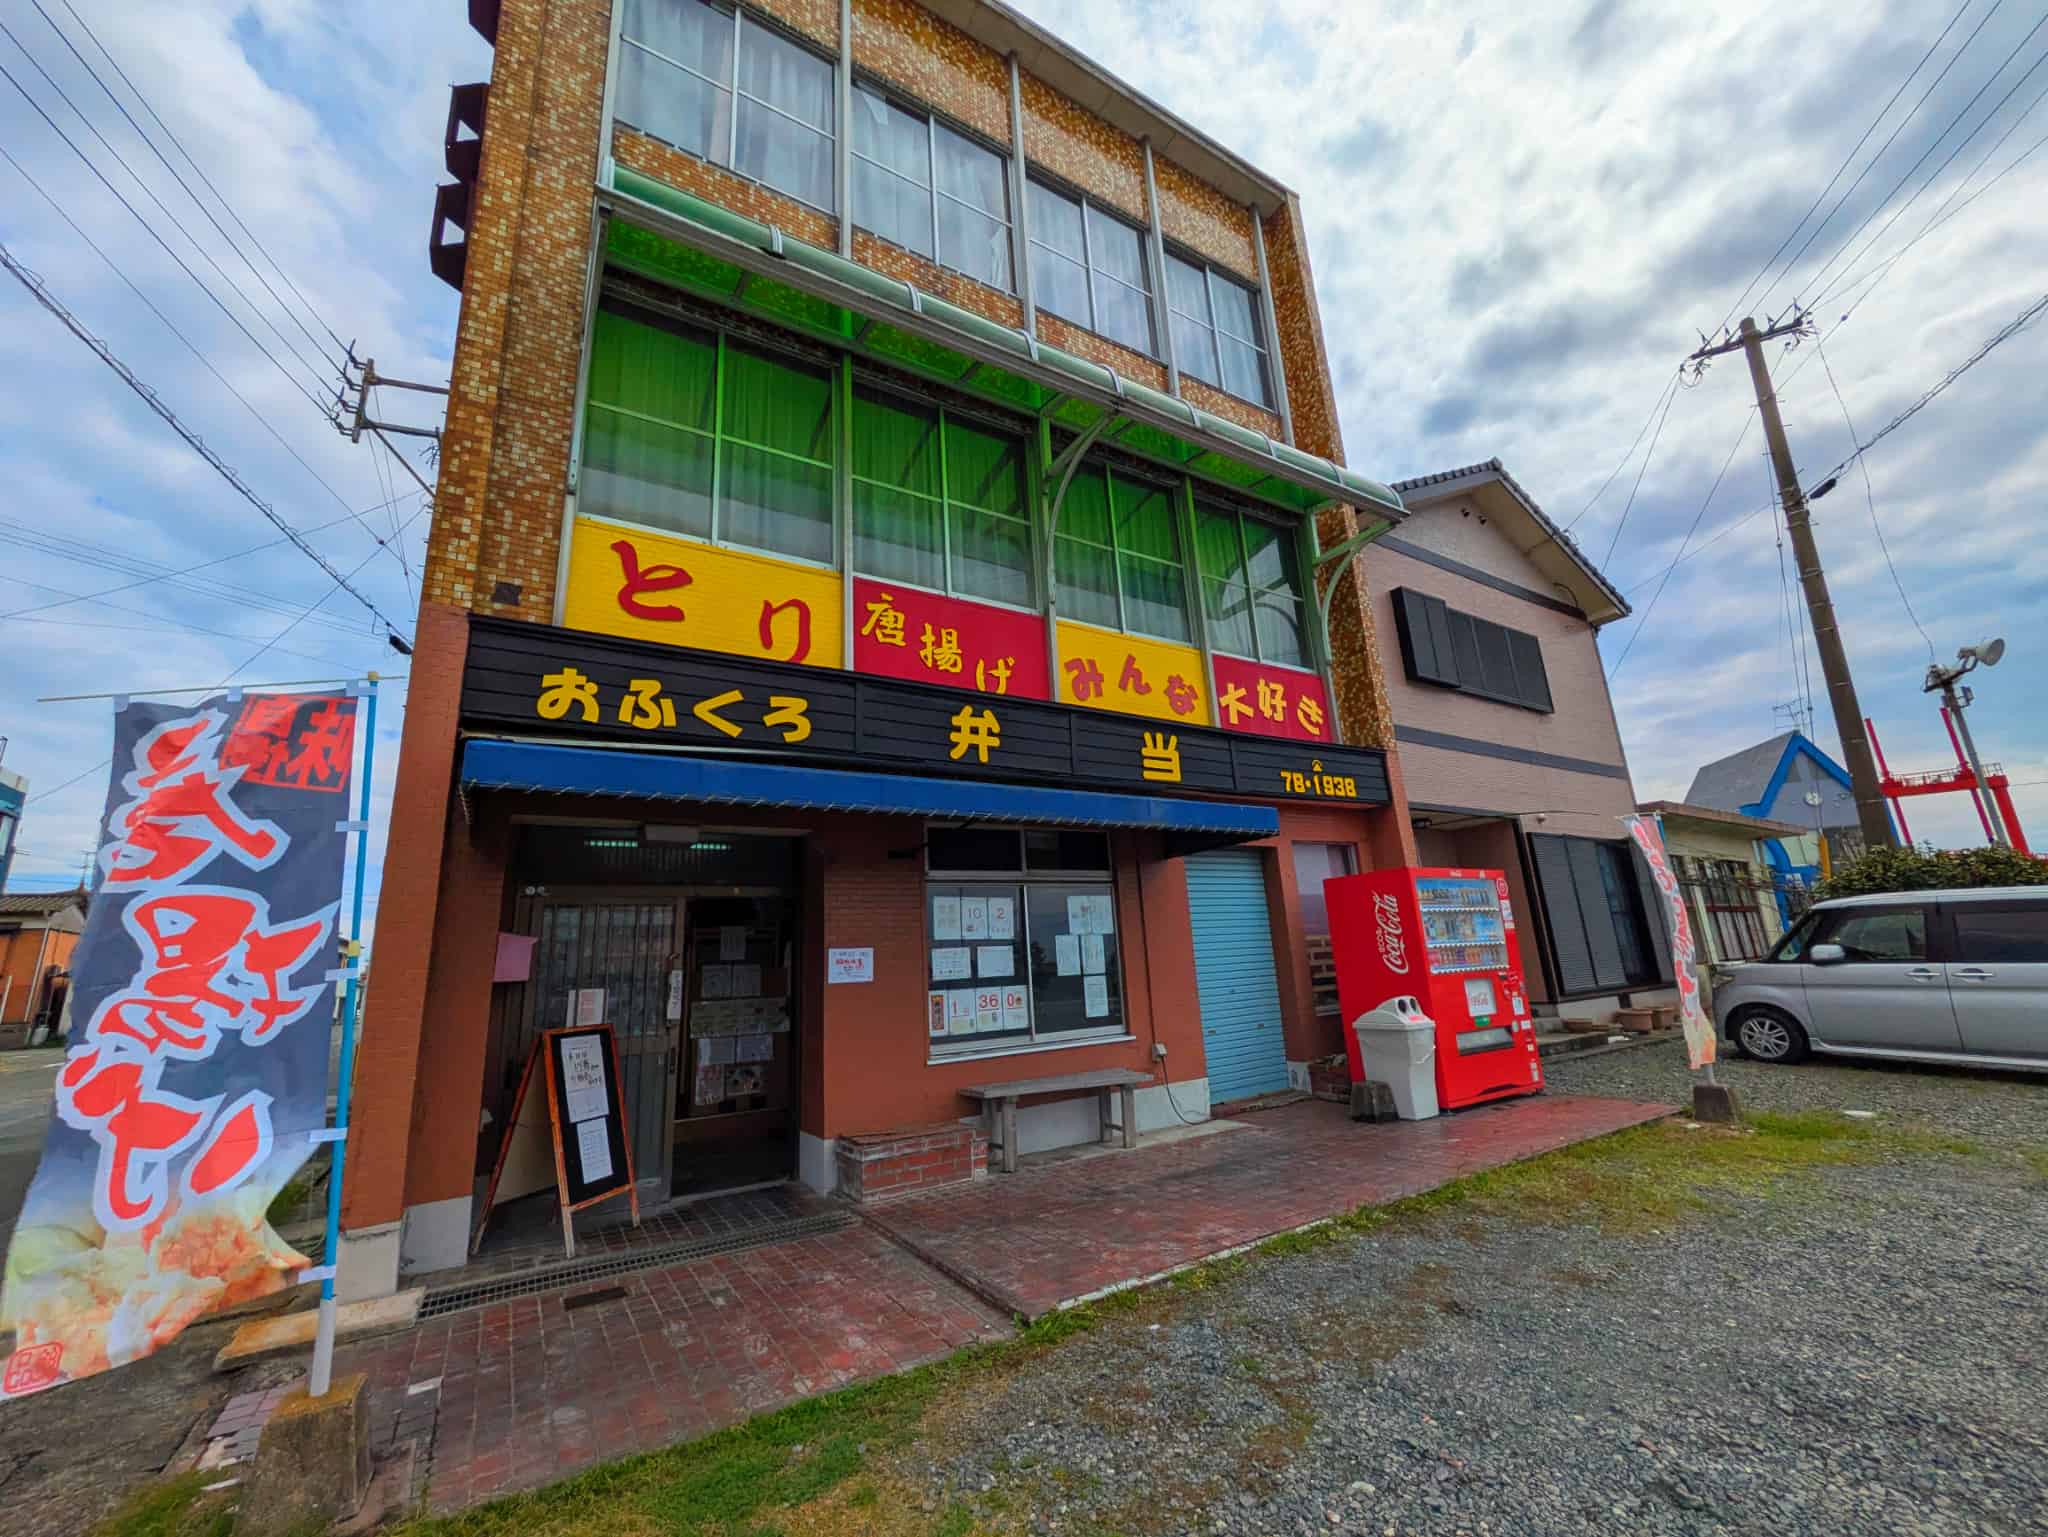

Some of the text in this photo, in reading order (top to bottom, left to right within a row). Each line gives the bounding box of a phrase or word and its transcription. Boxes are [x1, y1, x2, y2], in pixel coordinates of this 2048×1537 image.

[610, 540, 811, 663] とり
[861, 592, 1016, 695] 唐揚げ
[1063, 654, 1199, 715] みんな
[1218, 677, 1325, 736] 大好き
[1371, 889, 1409, 975] Coca-Cola
